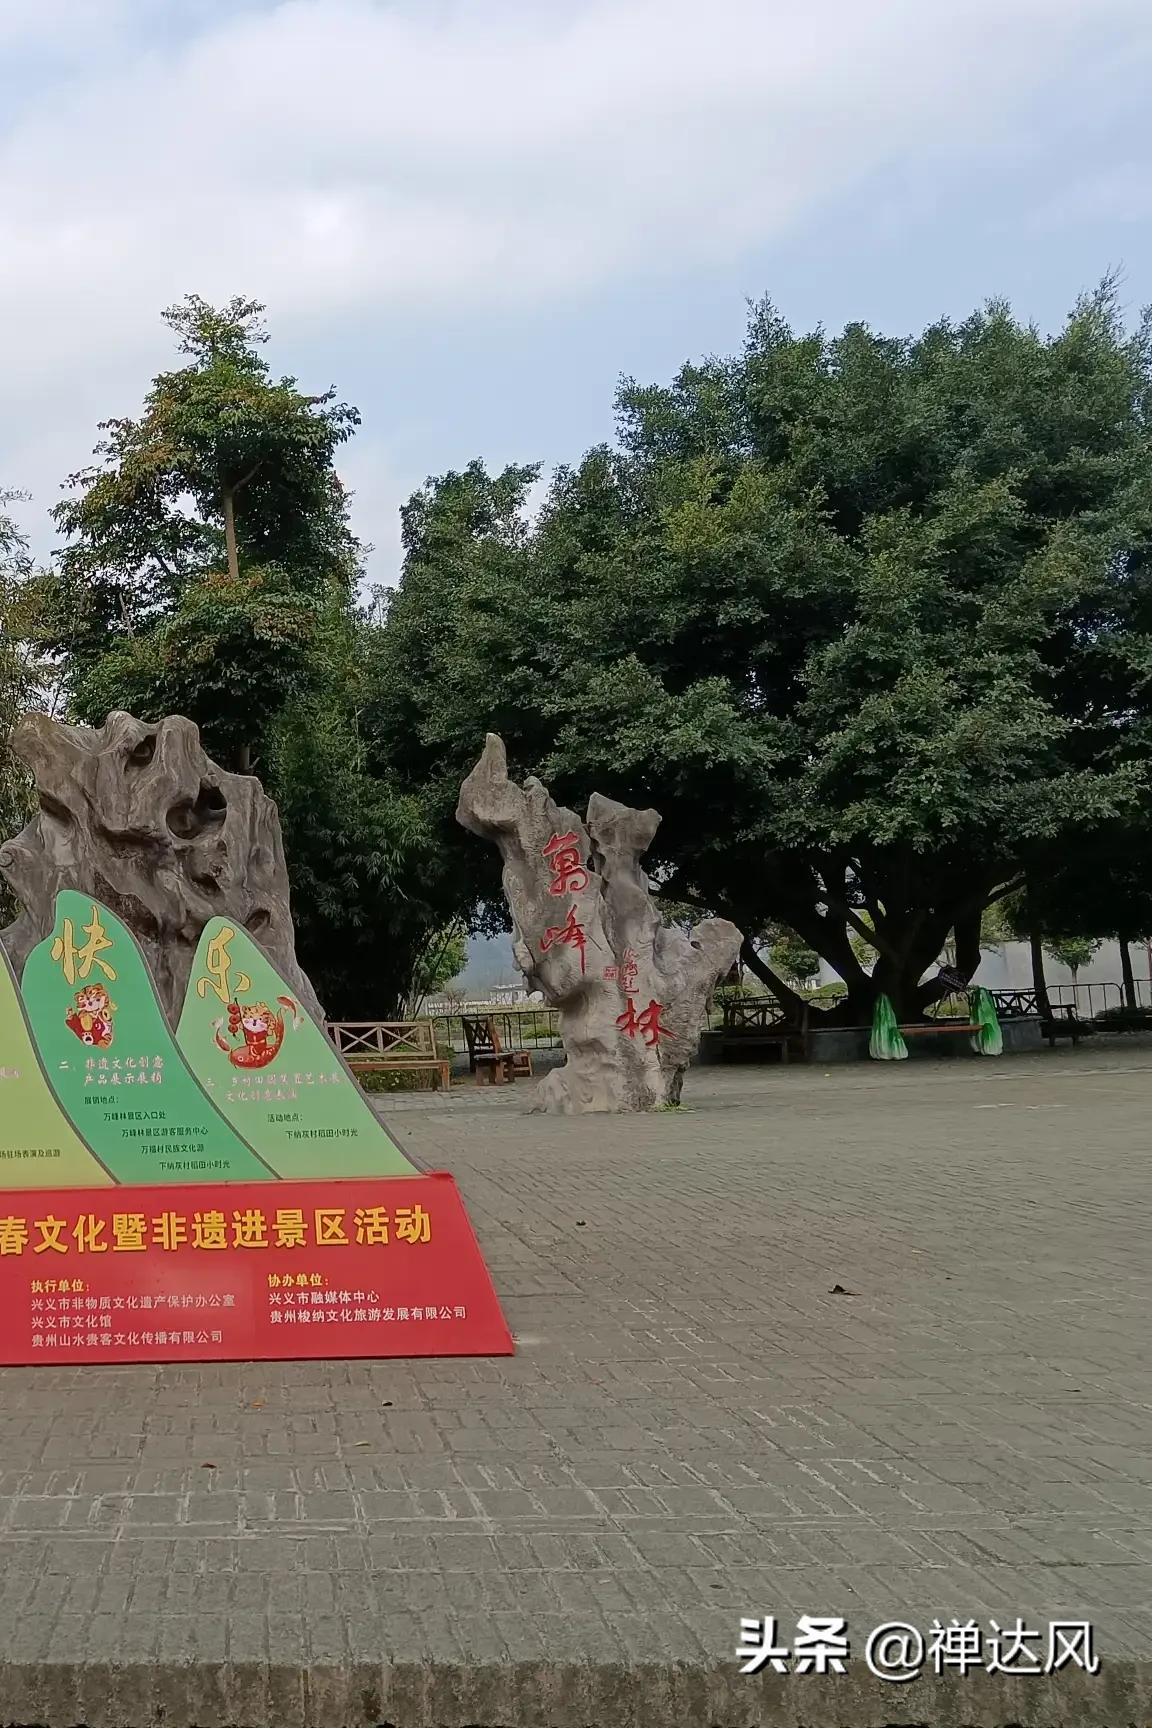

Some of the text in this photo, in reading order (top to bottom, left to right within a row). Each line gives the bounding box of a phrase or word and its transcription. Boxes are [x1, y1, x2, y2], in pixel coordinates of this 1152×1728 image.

[51, 905, 117, 985] 快
[197, 926, 251, 1003] 乐
[31, 1293, 236, 1312] 兴义市非物质文化遗产保护办公室
[268, 1290, 380, 1306] 兴义市融媒体中心
[31, 1314, 112, 1329] 兴义市文化馆
[31, 1330, 223, 1347] 贵州山水贵客文化传播有限公司
